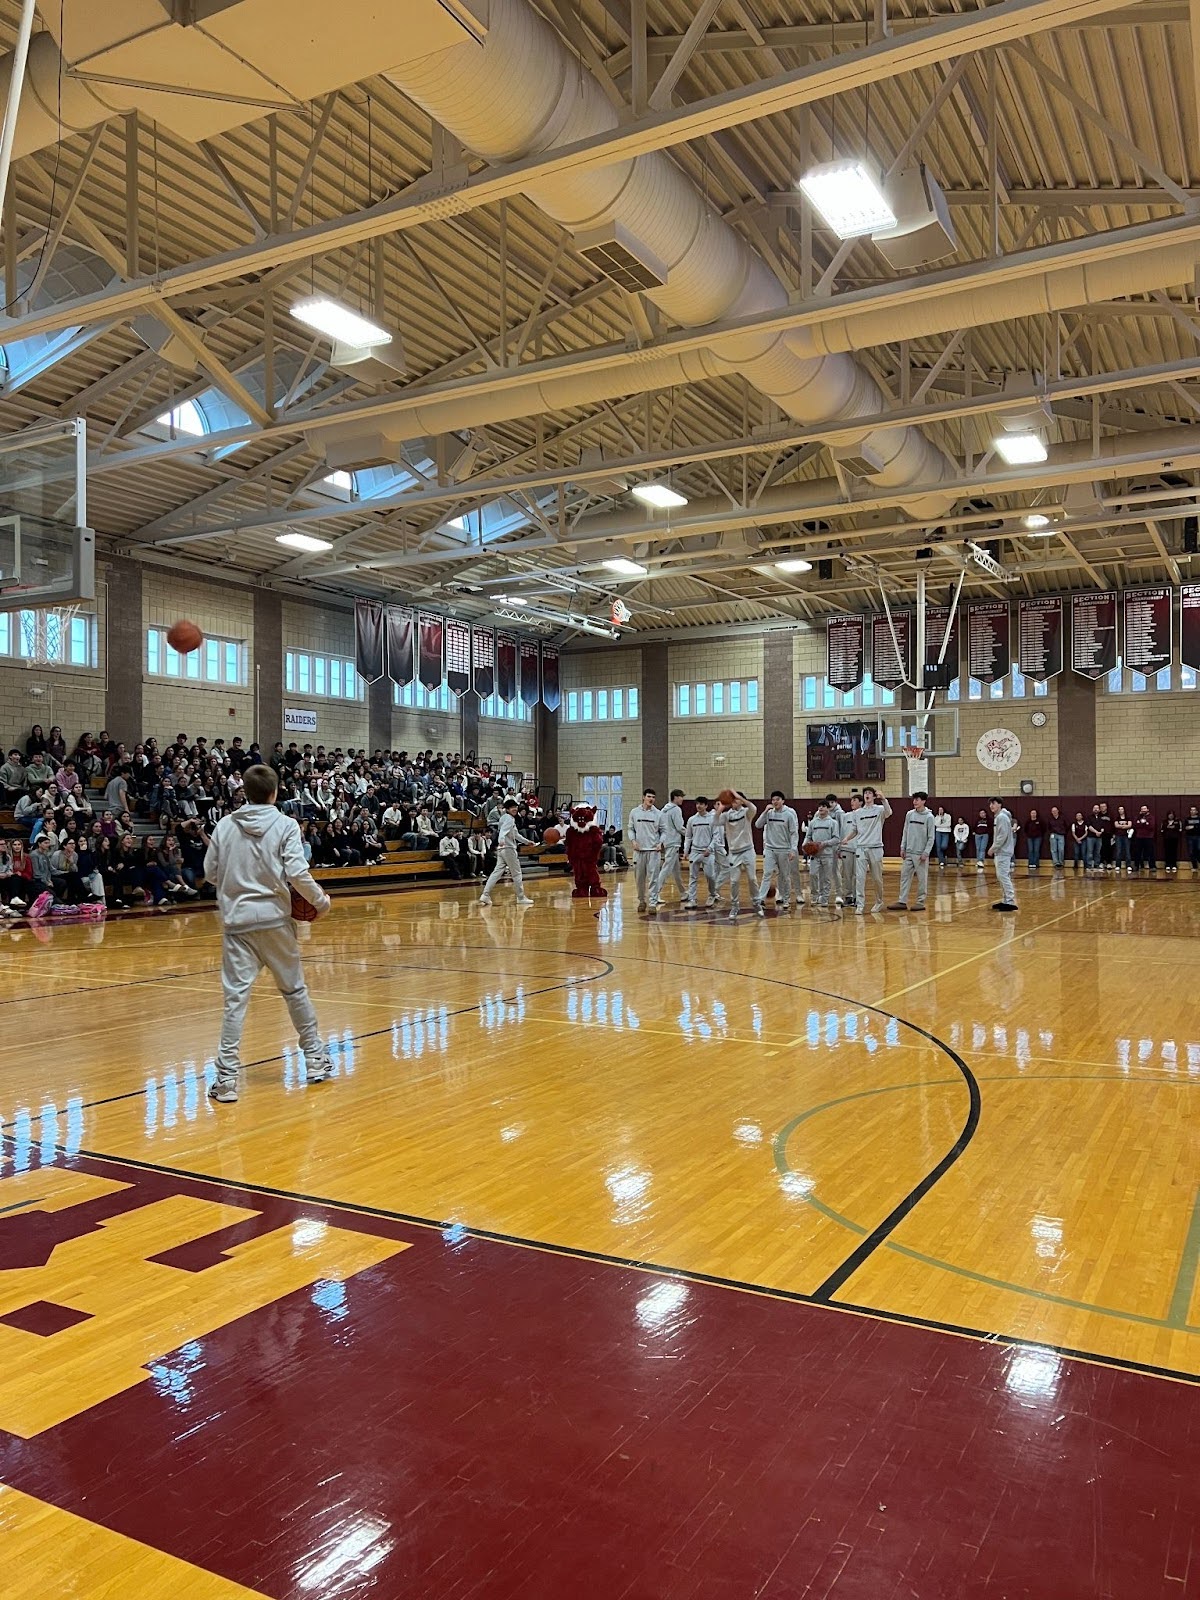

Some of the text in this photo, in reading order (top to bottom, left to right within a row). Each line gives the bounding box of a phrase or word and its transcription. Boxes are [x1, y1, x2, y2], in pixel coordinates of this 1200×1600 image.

[1126, 590, 1164, 599] SECTION
[1021, 599, 1056, 608] SECTION
[1073, 595, 1110, 604] SECTION
[969, 604, 1003, 613] SECTION
[285, 714, 316, 726] RAIDERS
